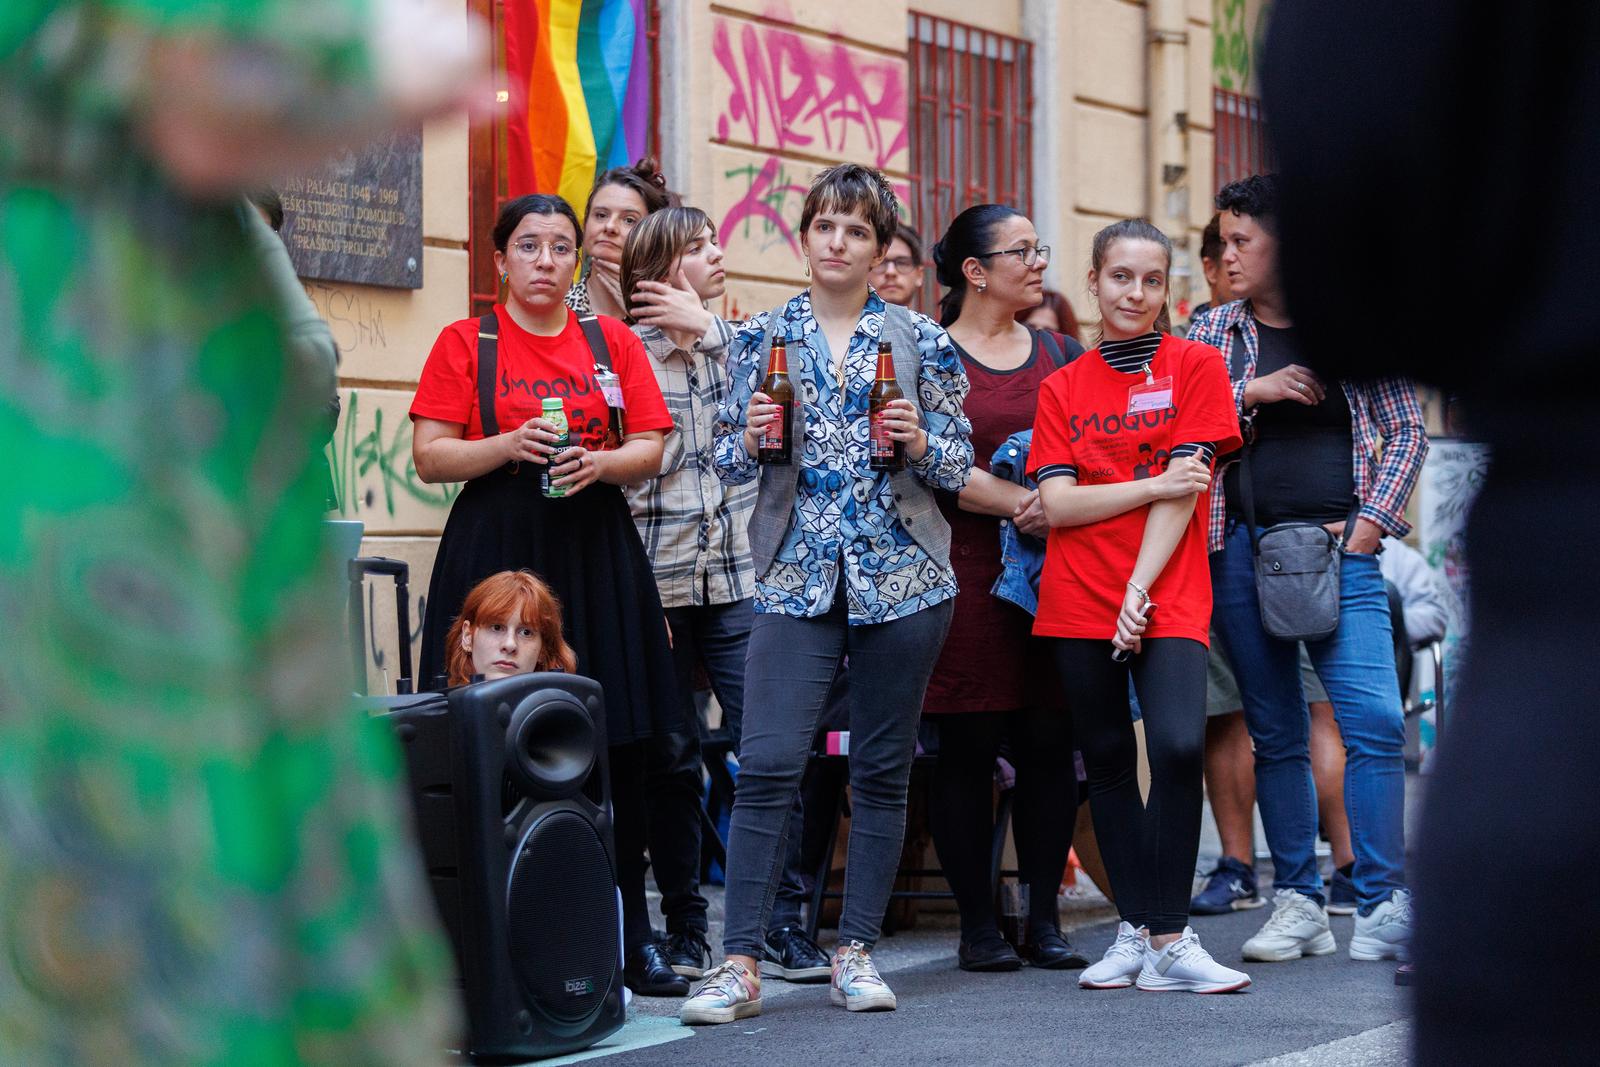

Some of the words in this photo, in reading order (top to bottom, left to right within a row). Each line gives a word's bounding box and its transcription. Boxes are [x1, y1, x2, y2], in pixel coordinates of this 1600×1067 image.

[307, 179, 347, 198] PALACH
[307, 202, 349, 218] STUDENT
[356, 207, 406, 225] DOMOLJUB
[296, 216, 347, 235] ISTAKNUTI
[1069, 403, 1178, 443] SMOQUA
